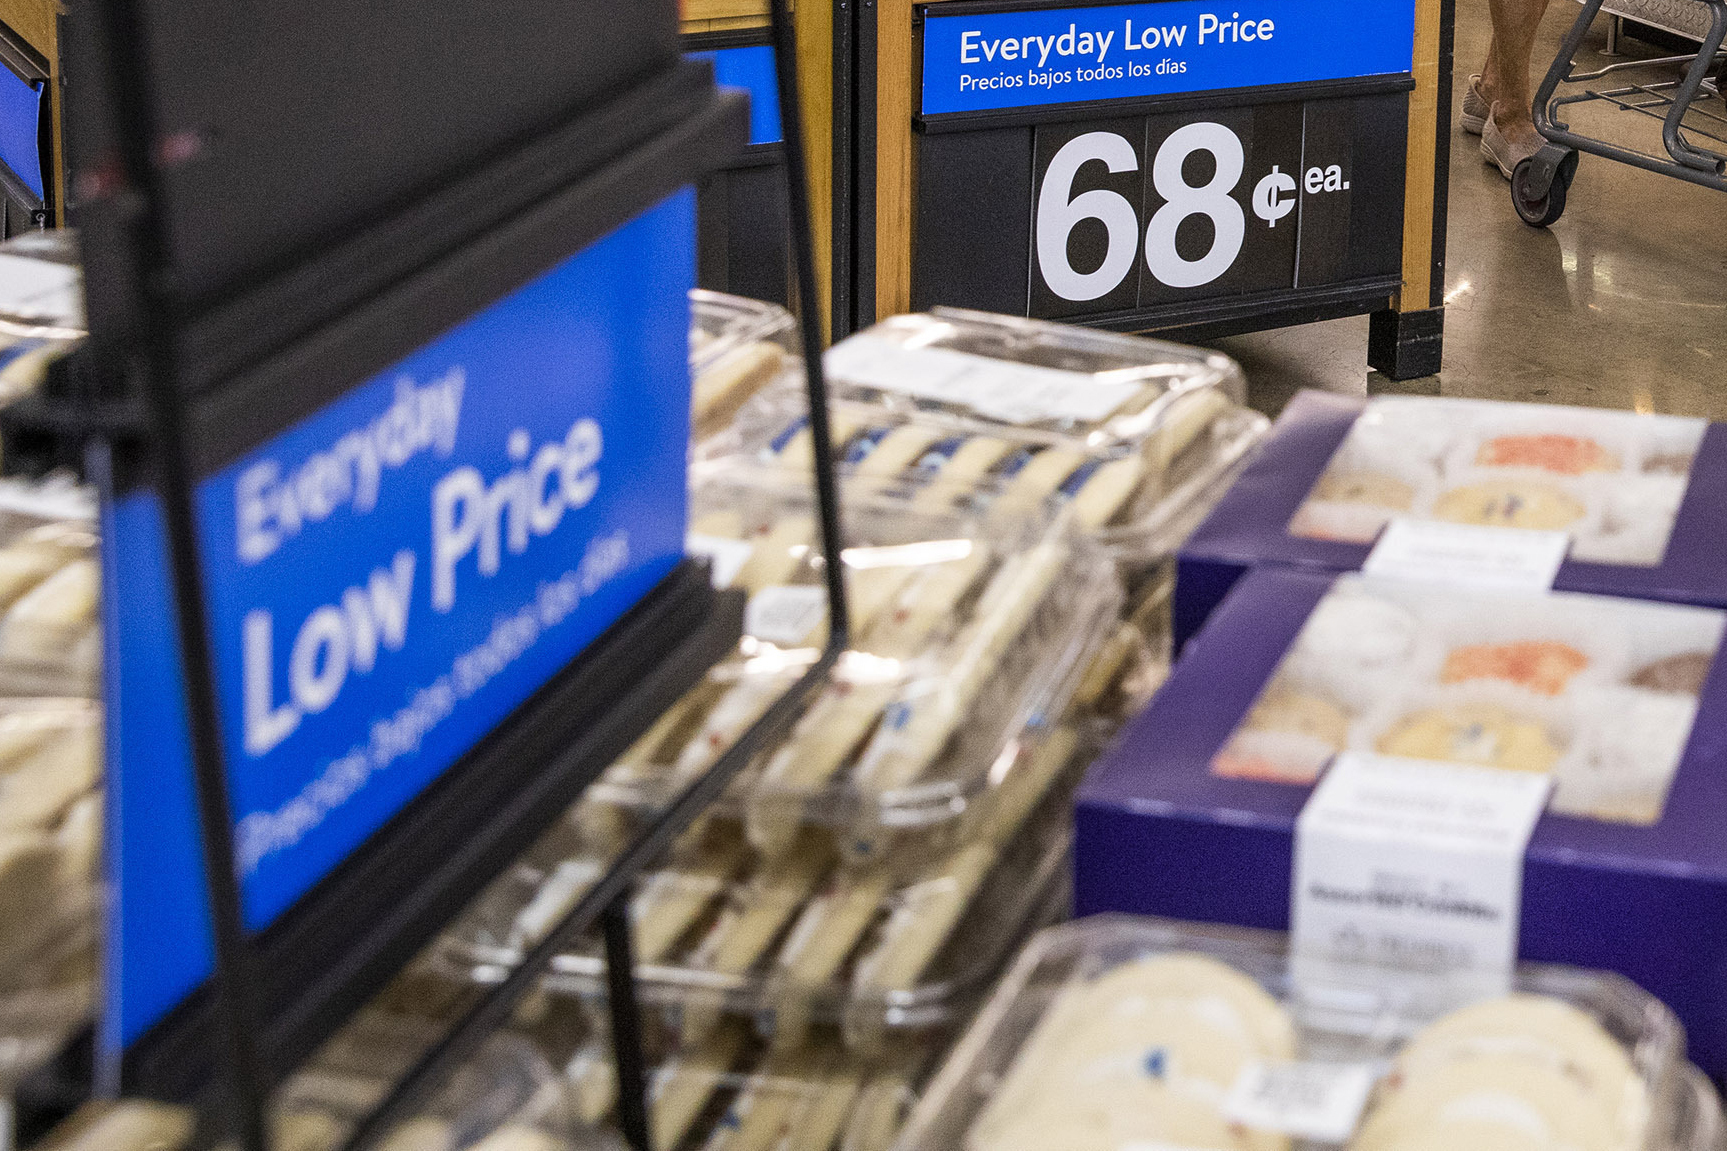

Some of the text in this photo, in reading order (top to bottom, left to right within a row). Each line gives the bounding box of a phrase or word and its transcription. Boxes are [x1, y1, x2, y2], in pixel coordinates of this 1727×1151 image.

[959, 57, 1188, 92] Precios bajos todos los días
[960, 11, 1275, 67] Everyday Low Price
[1036, 122, 1350, 302] 68¢ ea.
[235, 363, 467, 566] Everyday
[242, 416, 604, 758] Low Price
